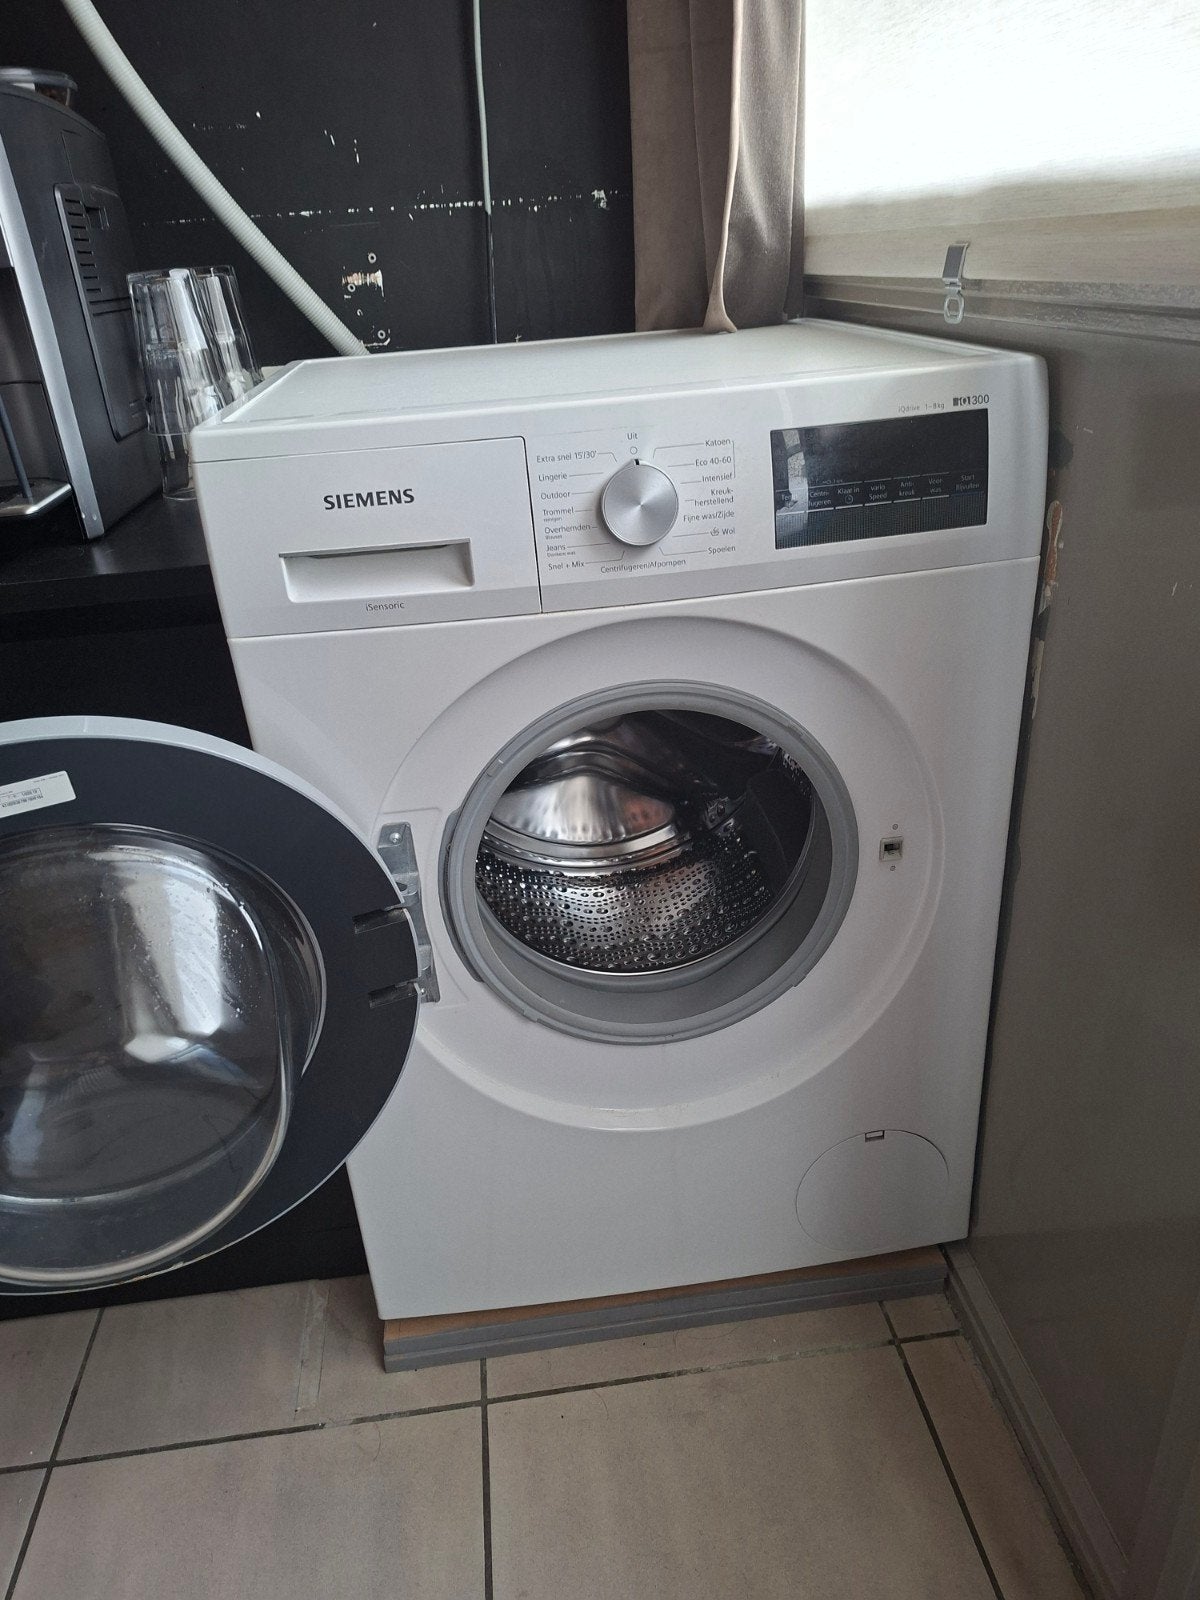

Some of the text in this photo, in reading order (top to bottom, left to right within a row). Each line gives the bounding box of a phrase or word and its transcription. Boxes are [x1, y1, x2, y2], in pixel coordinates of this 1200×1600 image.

[627, 432, 638, 440] Uit
[705, 438, 731, 447] Katoen
[536, 454, 556, 463] Extra
[557, 453, 572, 462] snel
[695, 456, 732, 467] Eco 40-60
[538, 472, 568, 483] Lingerie
[702, 473, 733, 482] Intensief
[540, 490, 571, 500] Outdoor
[710, 488, 734, 496] Kreuk-
[868, 491, 888, 501] Speed
[323, 488, 415, 511] SIEMENS
[694, 496, 734, 507] herstellend
[542, 506, 574, 516] Trommel
[683, 509, 735, 523] Fijne was/Zijde
[544, 523, 591, 534] Overhemden
[721, 527, 736, 535] Wol
[545, 543, 566, 552] Jeans
[708, 545, 736, 555] Spoelen
[548, 562, 564, 571] Snel
[571, 561, 585, 569] Mix
[600, 559, 686, 574] Centrifugeren/Afpompen
[365, 600, 405, 613] iSensoric
